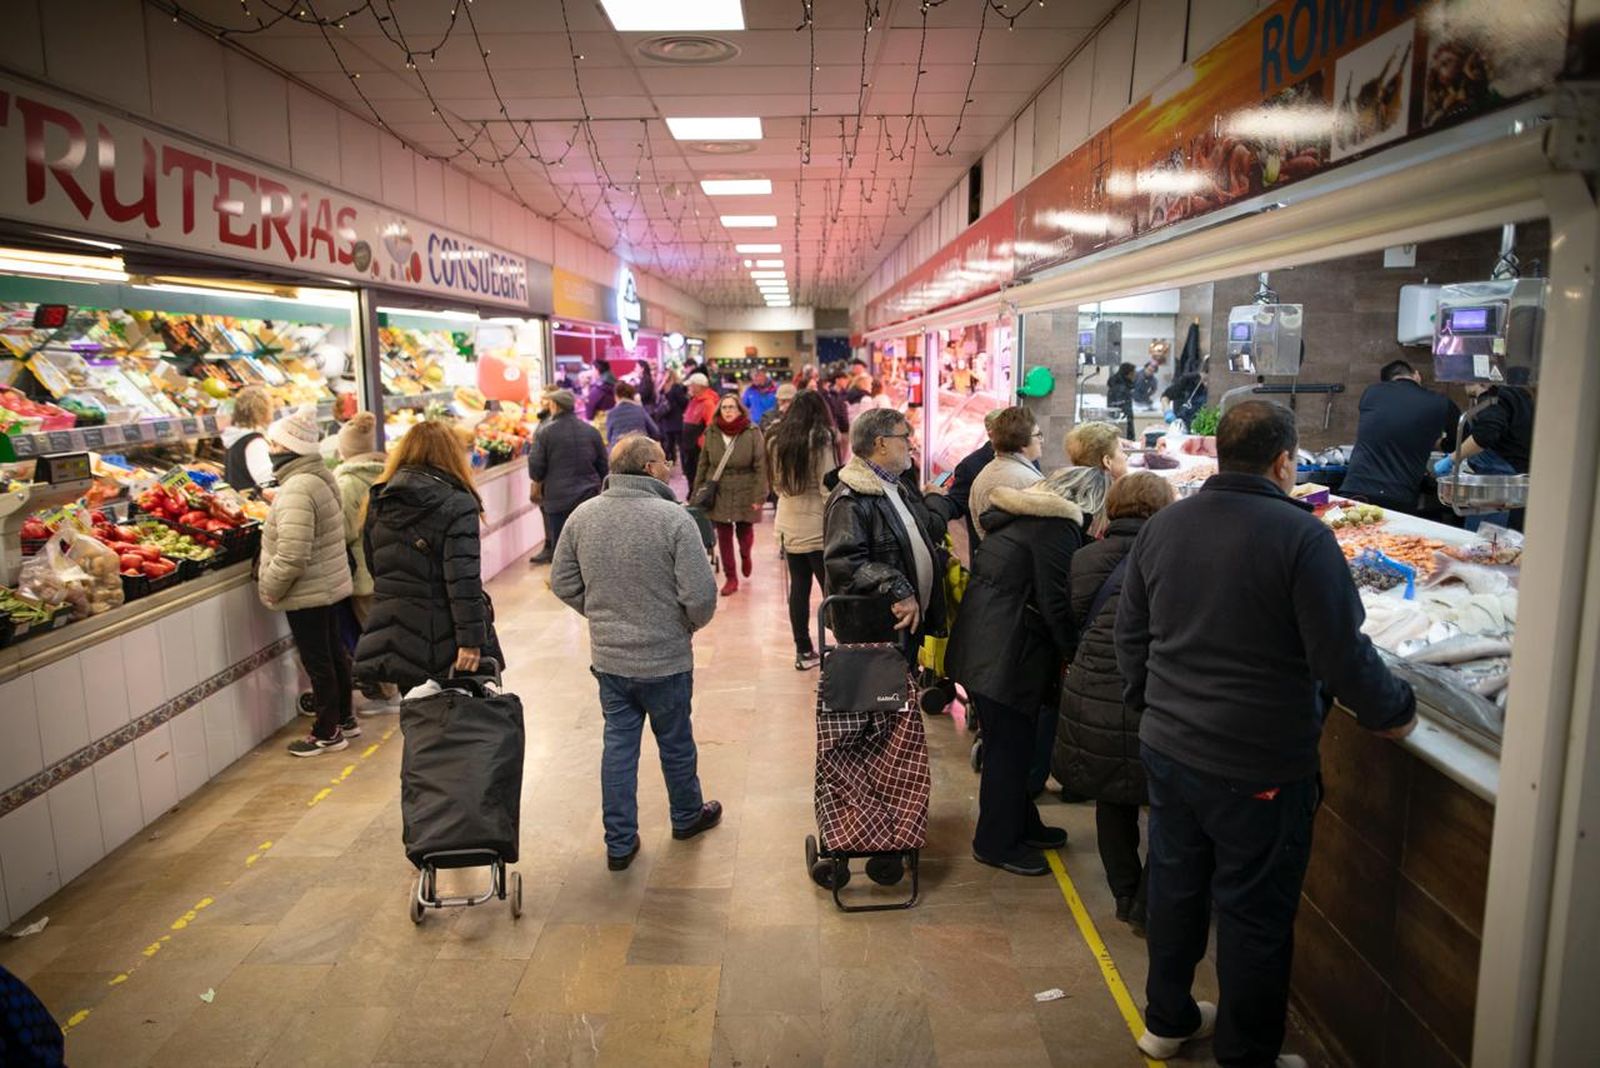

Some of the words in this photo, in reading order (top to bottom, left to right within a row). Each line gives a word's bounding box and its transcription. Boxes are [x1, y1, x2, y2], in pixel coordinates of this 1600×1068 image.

[1262, 0, 1406, 92] ROM
[0, 91, 358, 266] RUTERIAS
[428, 232, 527, 302] CONSUEGRA
